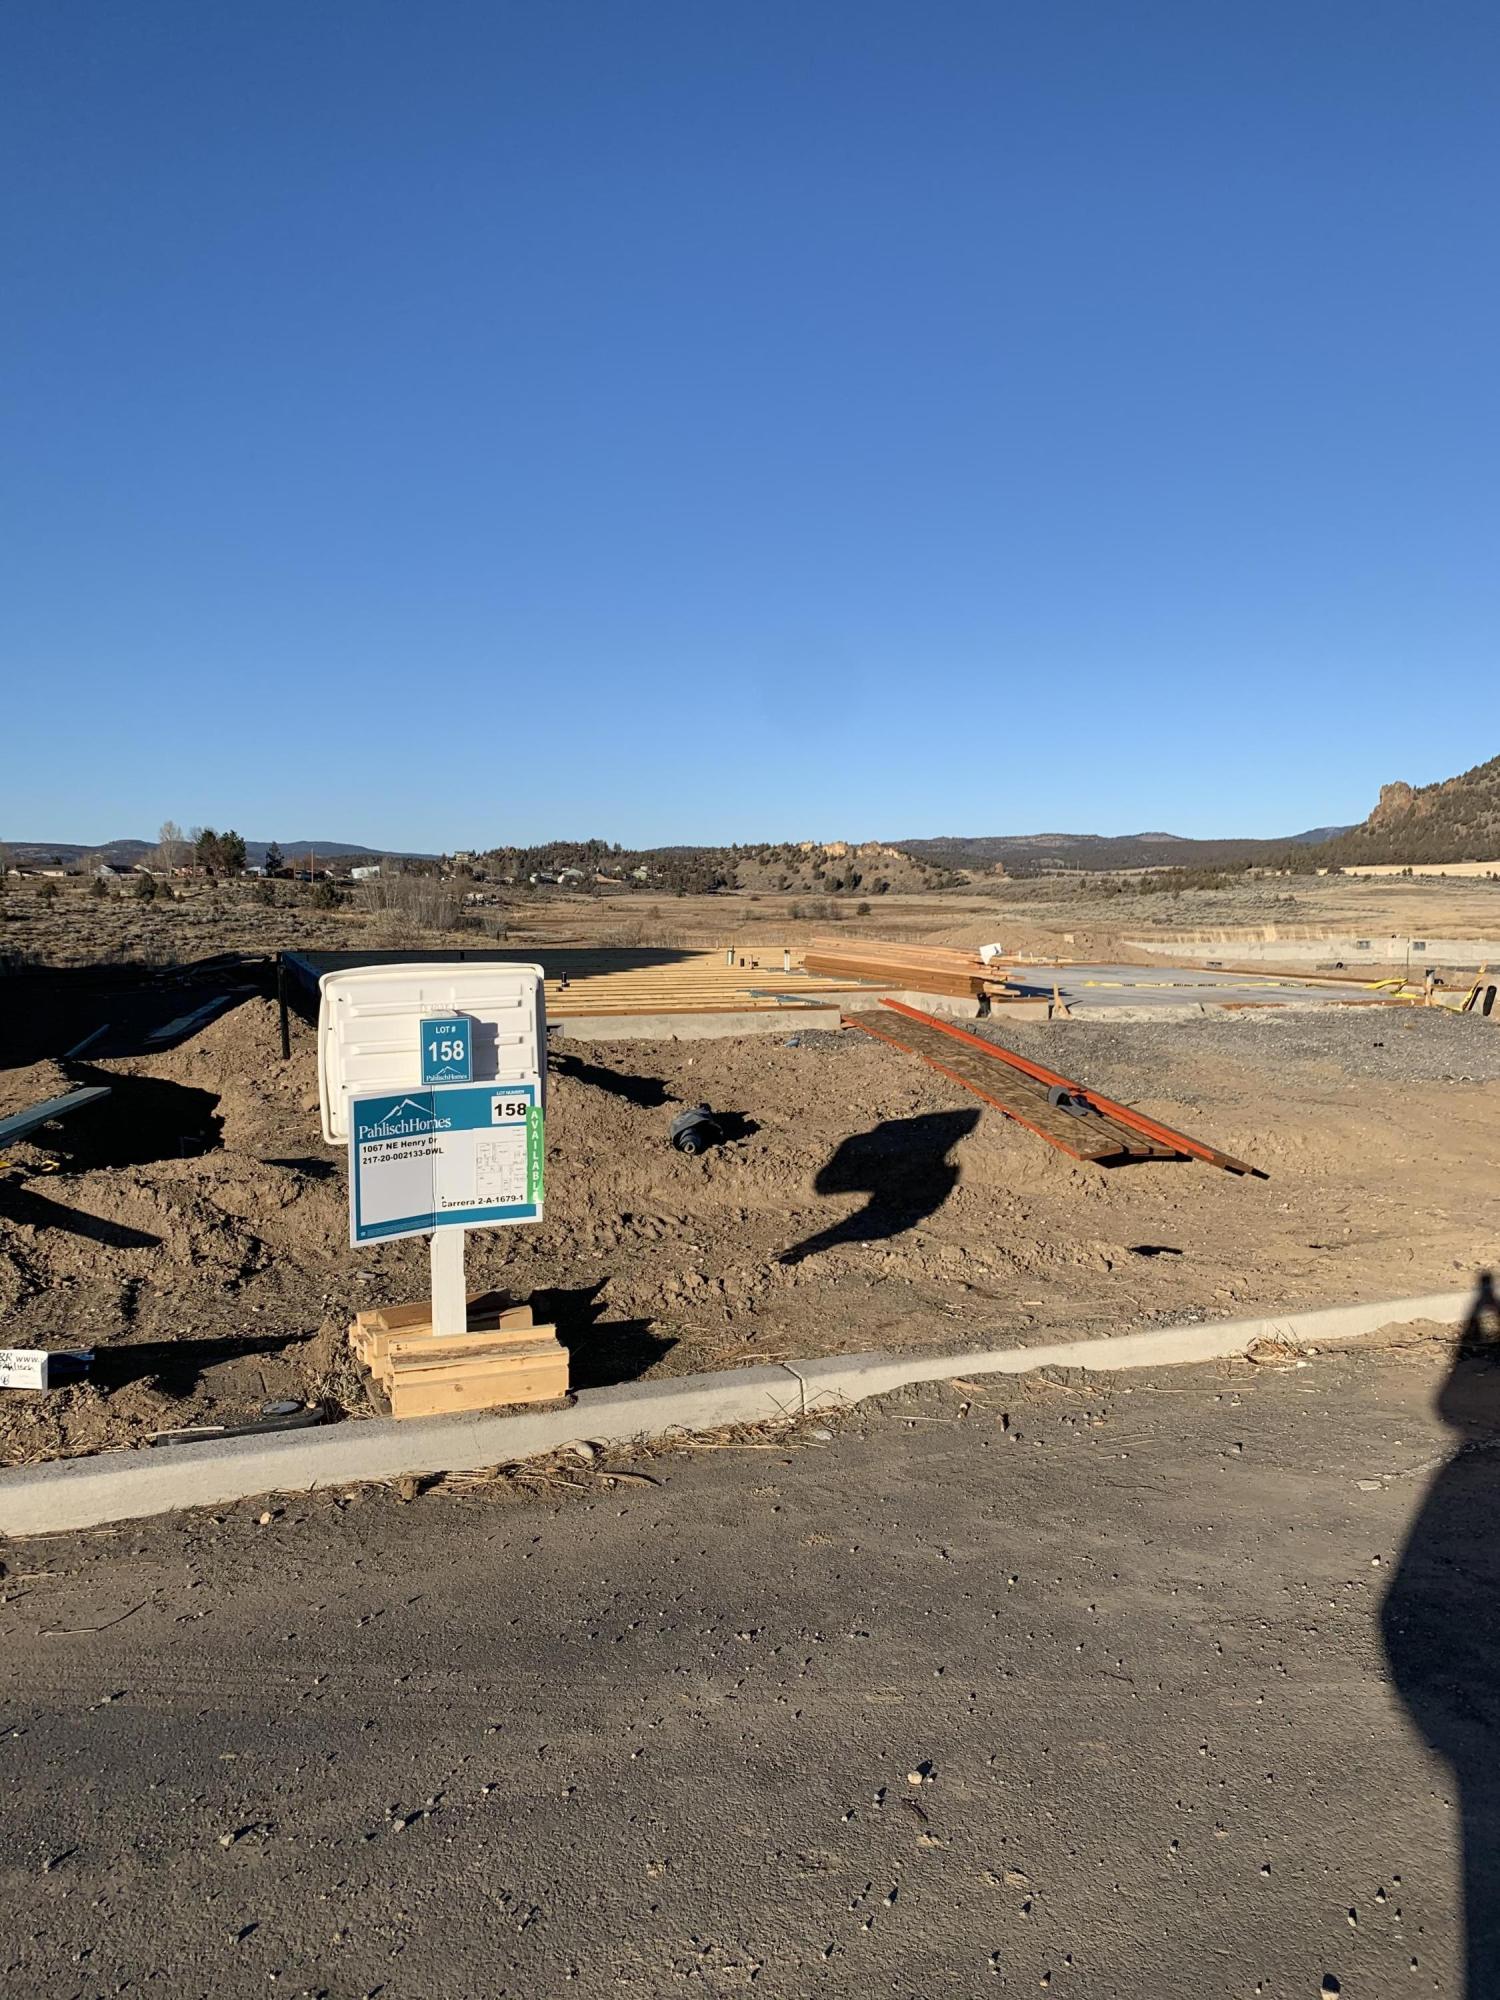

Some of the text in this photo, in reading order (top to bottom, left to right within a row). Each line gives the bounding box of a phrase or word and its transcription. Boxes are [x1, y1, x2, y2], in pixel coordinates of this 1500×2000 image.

[435, 1025, 456, 1034] LOT #
[428, 1040, 465, 1062] 158
[494, 1103, 527, 1117] 158
[358, 1117, 452, 1140] PahlischHomes
[362, 1143, 384, 1154] 1067
[386, 1141, 399, 1151] NE
[401, 1138, 426, 1149] Henry
[362, 1147, 444, 1165] 217-20-002133-DWL
[441, 1194, 524, 1208] Carrera 2-A-1679-1
